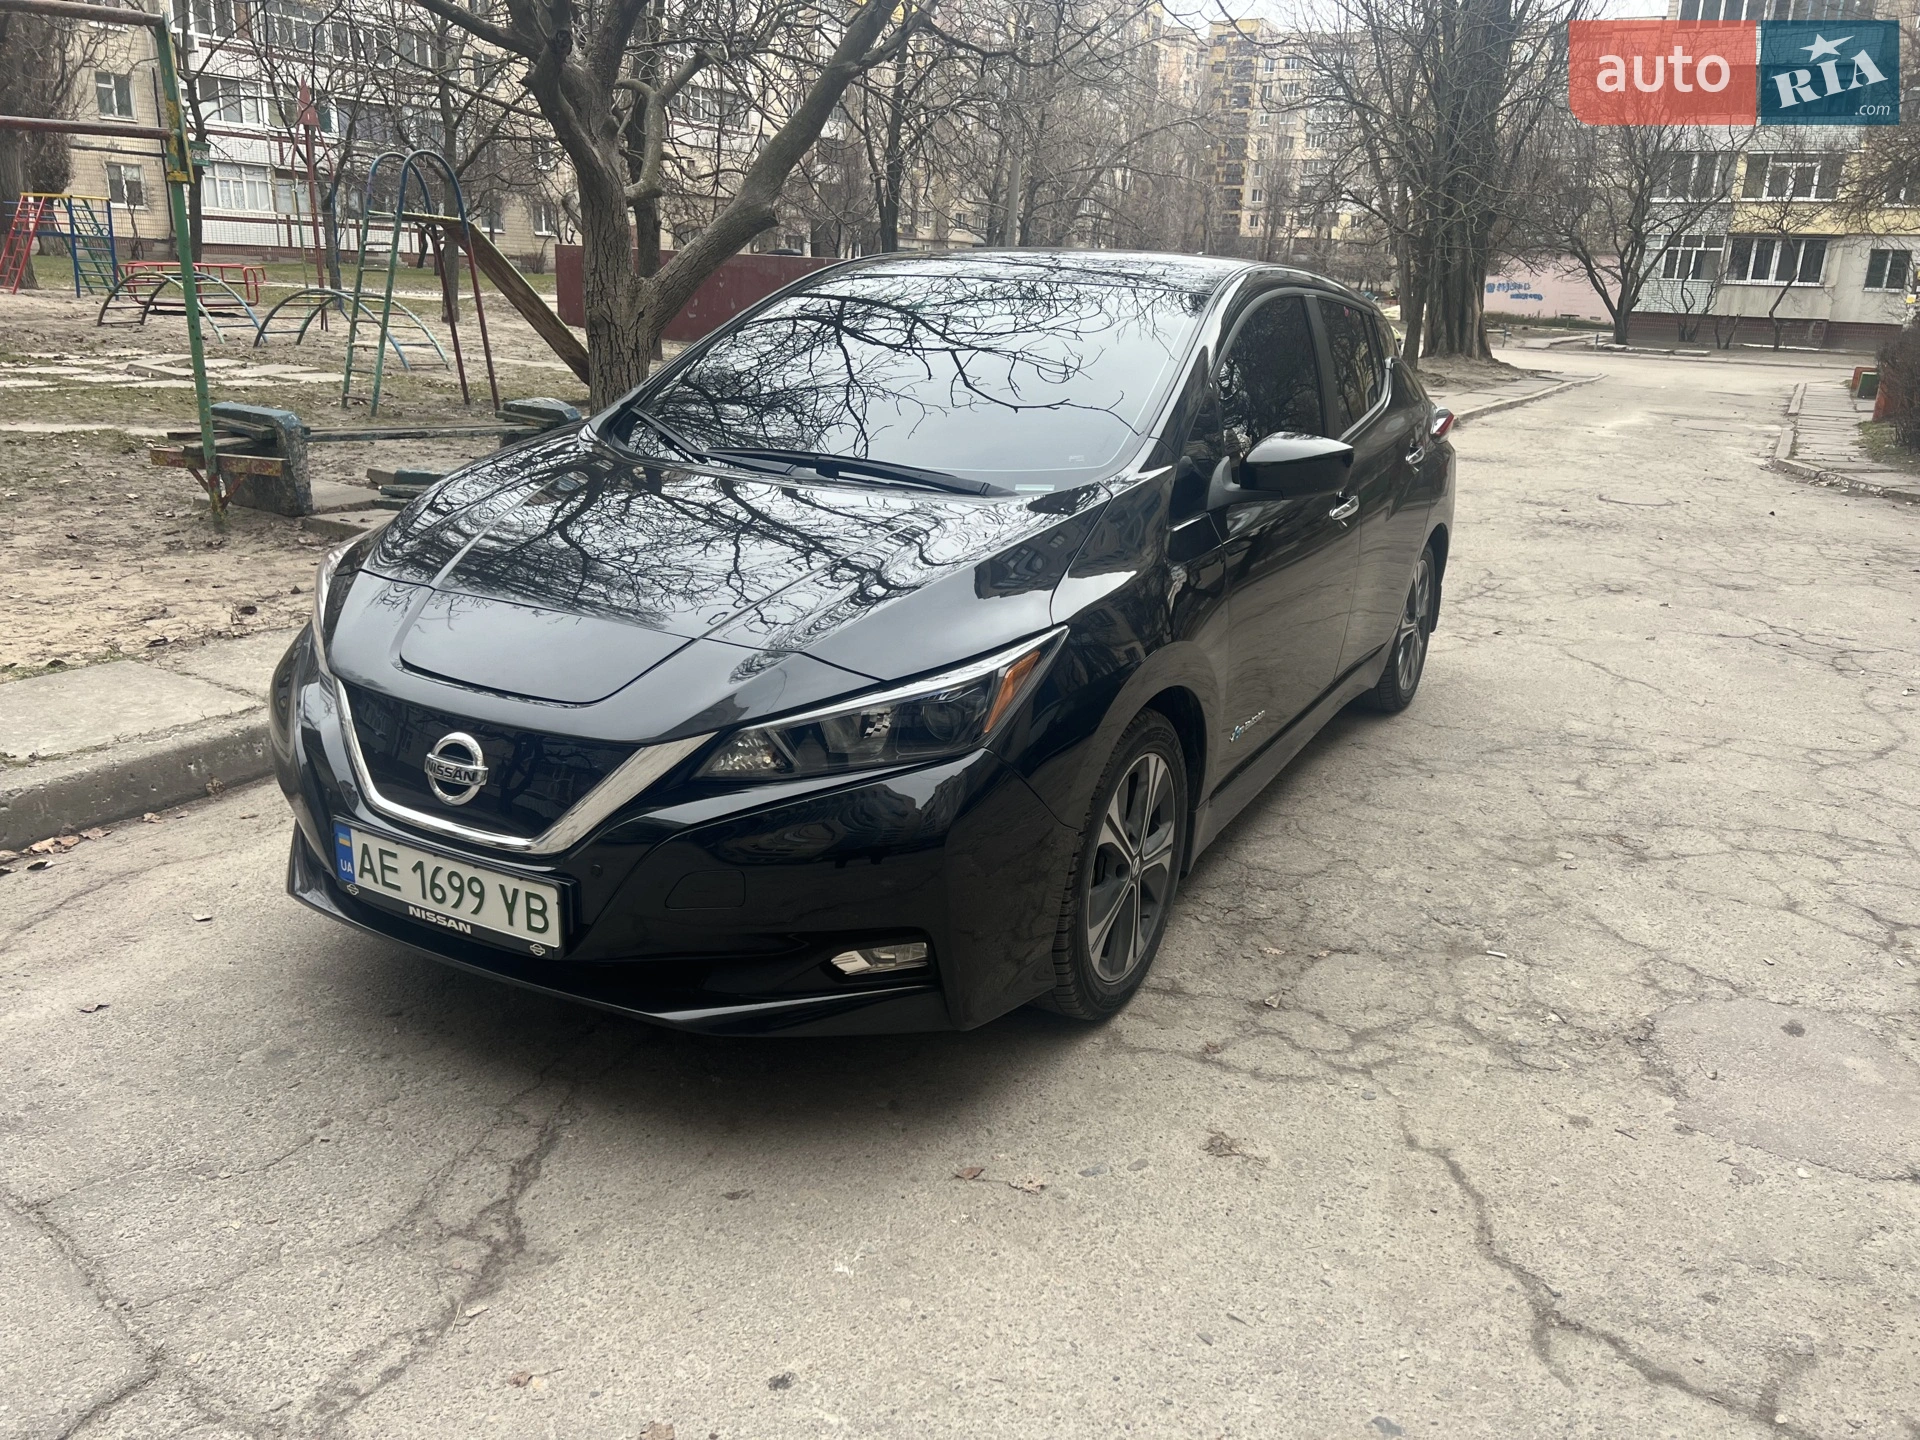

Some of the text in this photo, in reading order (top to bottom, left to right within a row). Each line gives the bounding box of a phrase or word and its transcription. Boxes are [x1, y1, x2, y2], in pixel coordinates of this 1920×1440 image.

[425, 759, 476, 782] NISSAN
[340, 858, 353, 874] UA
[358, 843, 549, 934] AE 1699 YB
[408, 905, 472, 934] NISSAN
